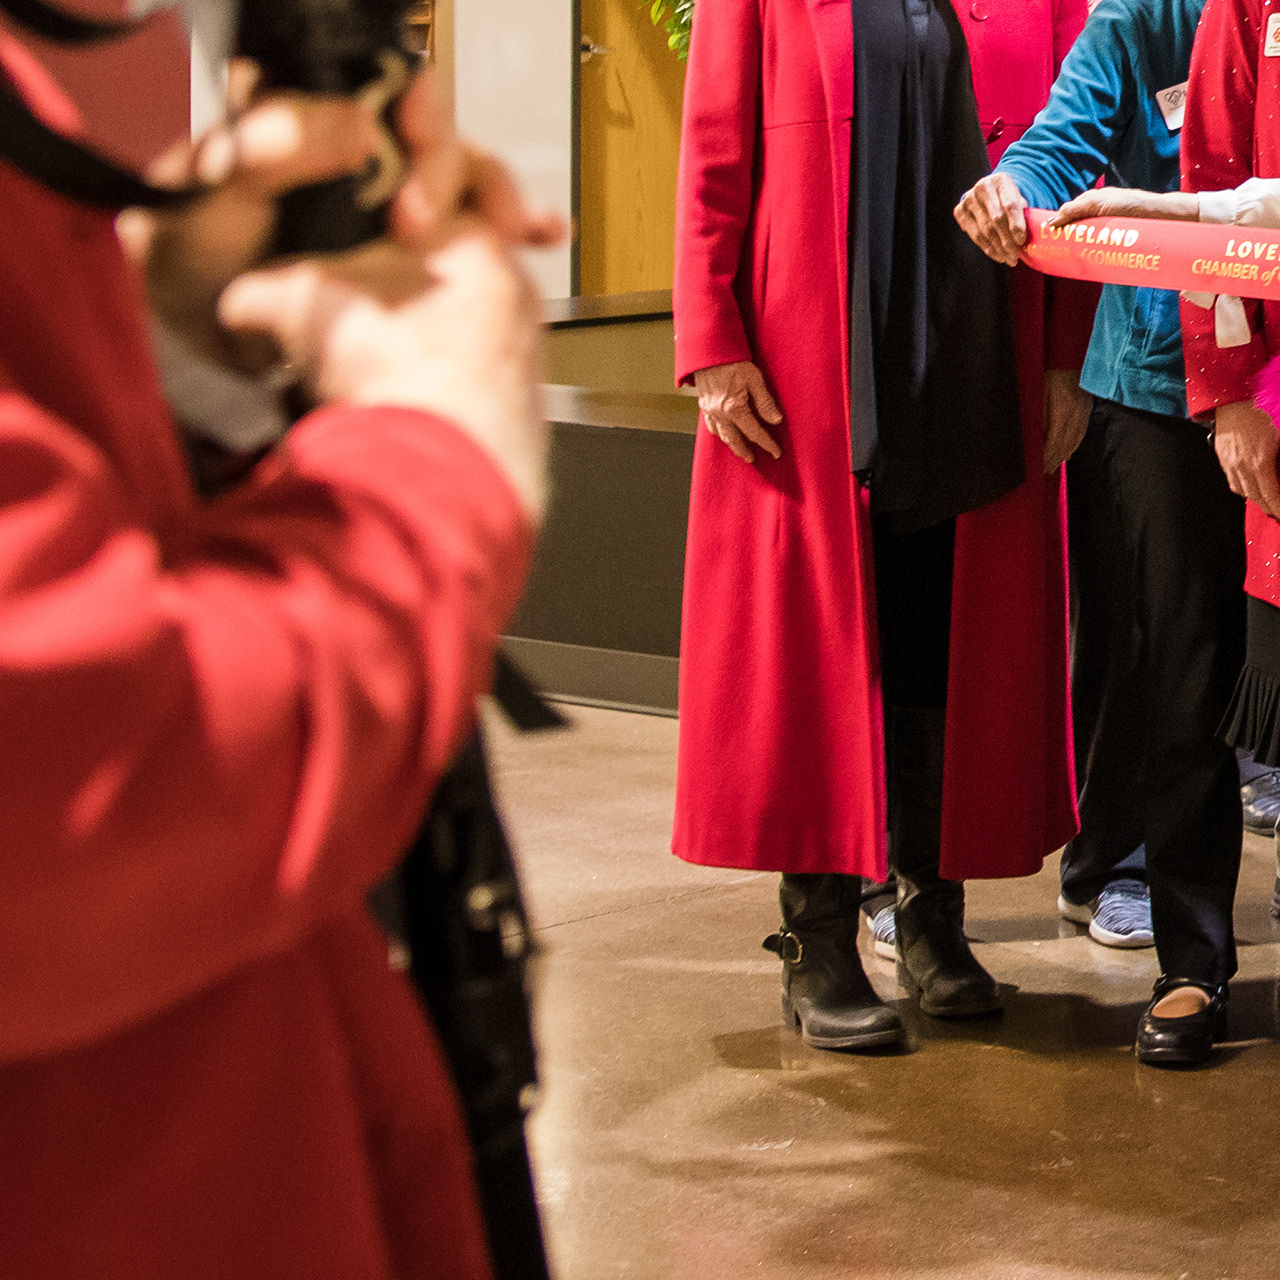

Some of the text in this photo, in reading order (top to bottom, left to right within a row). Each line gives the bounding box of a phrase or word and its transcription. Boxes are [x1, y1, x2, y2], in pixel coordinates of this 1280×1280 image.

[1088, 250, 1161, 271] COMMERCE
[1192, 258, 1259, 280] CHAMBER
[1260, 266, 1279, 286] of
